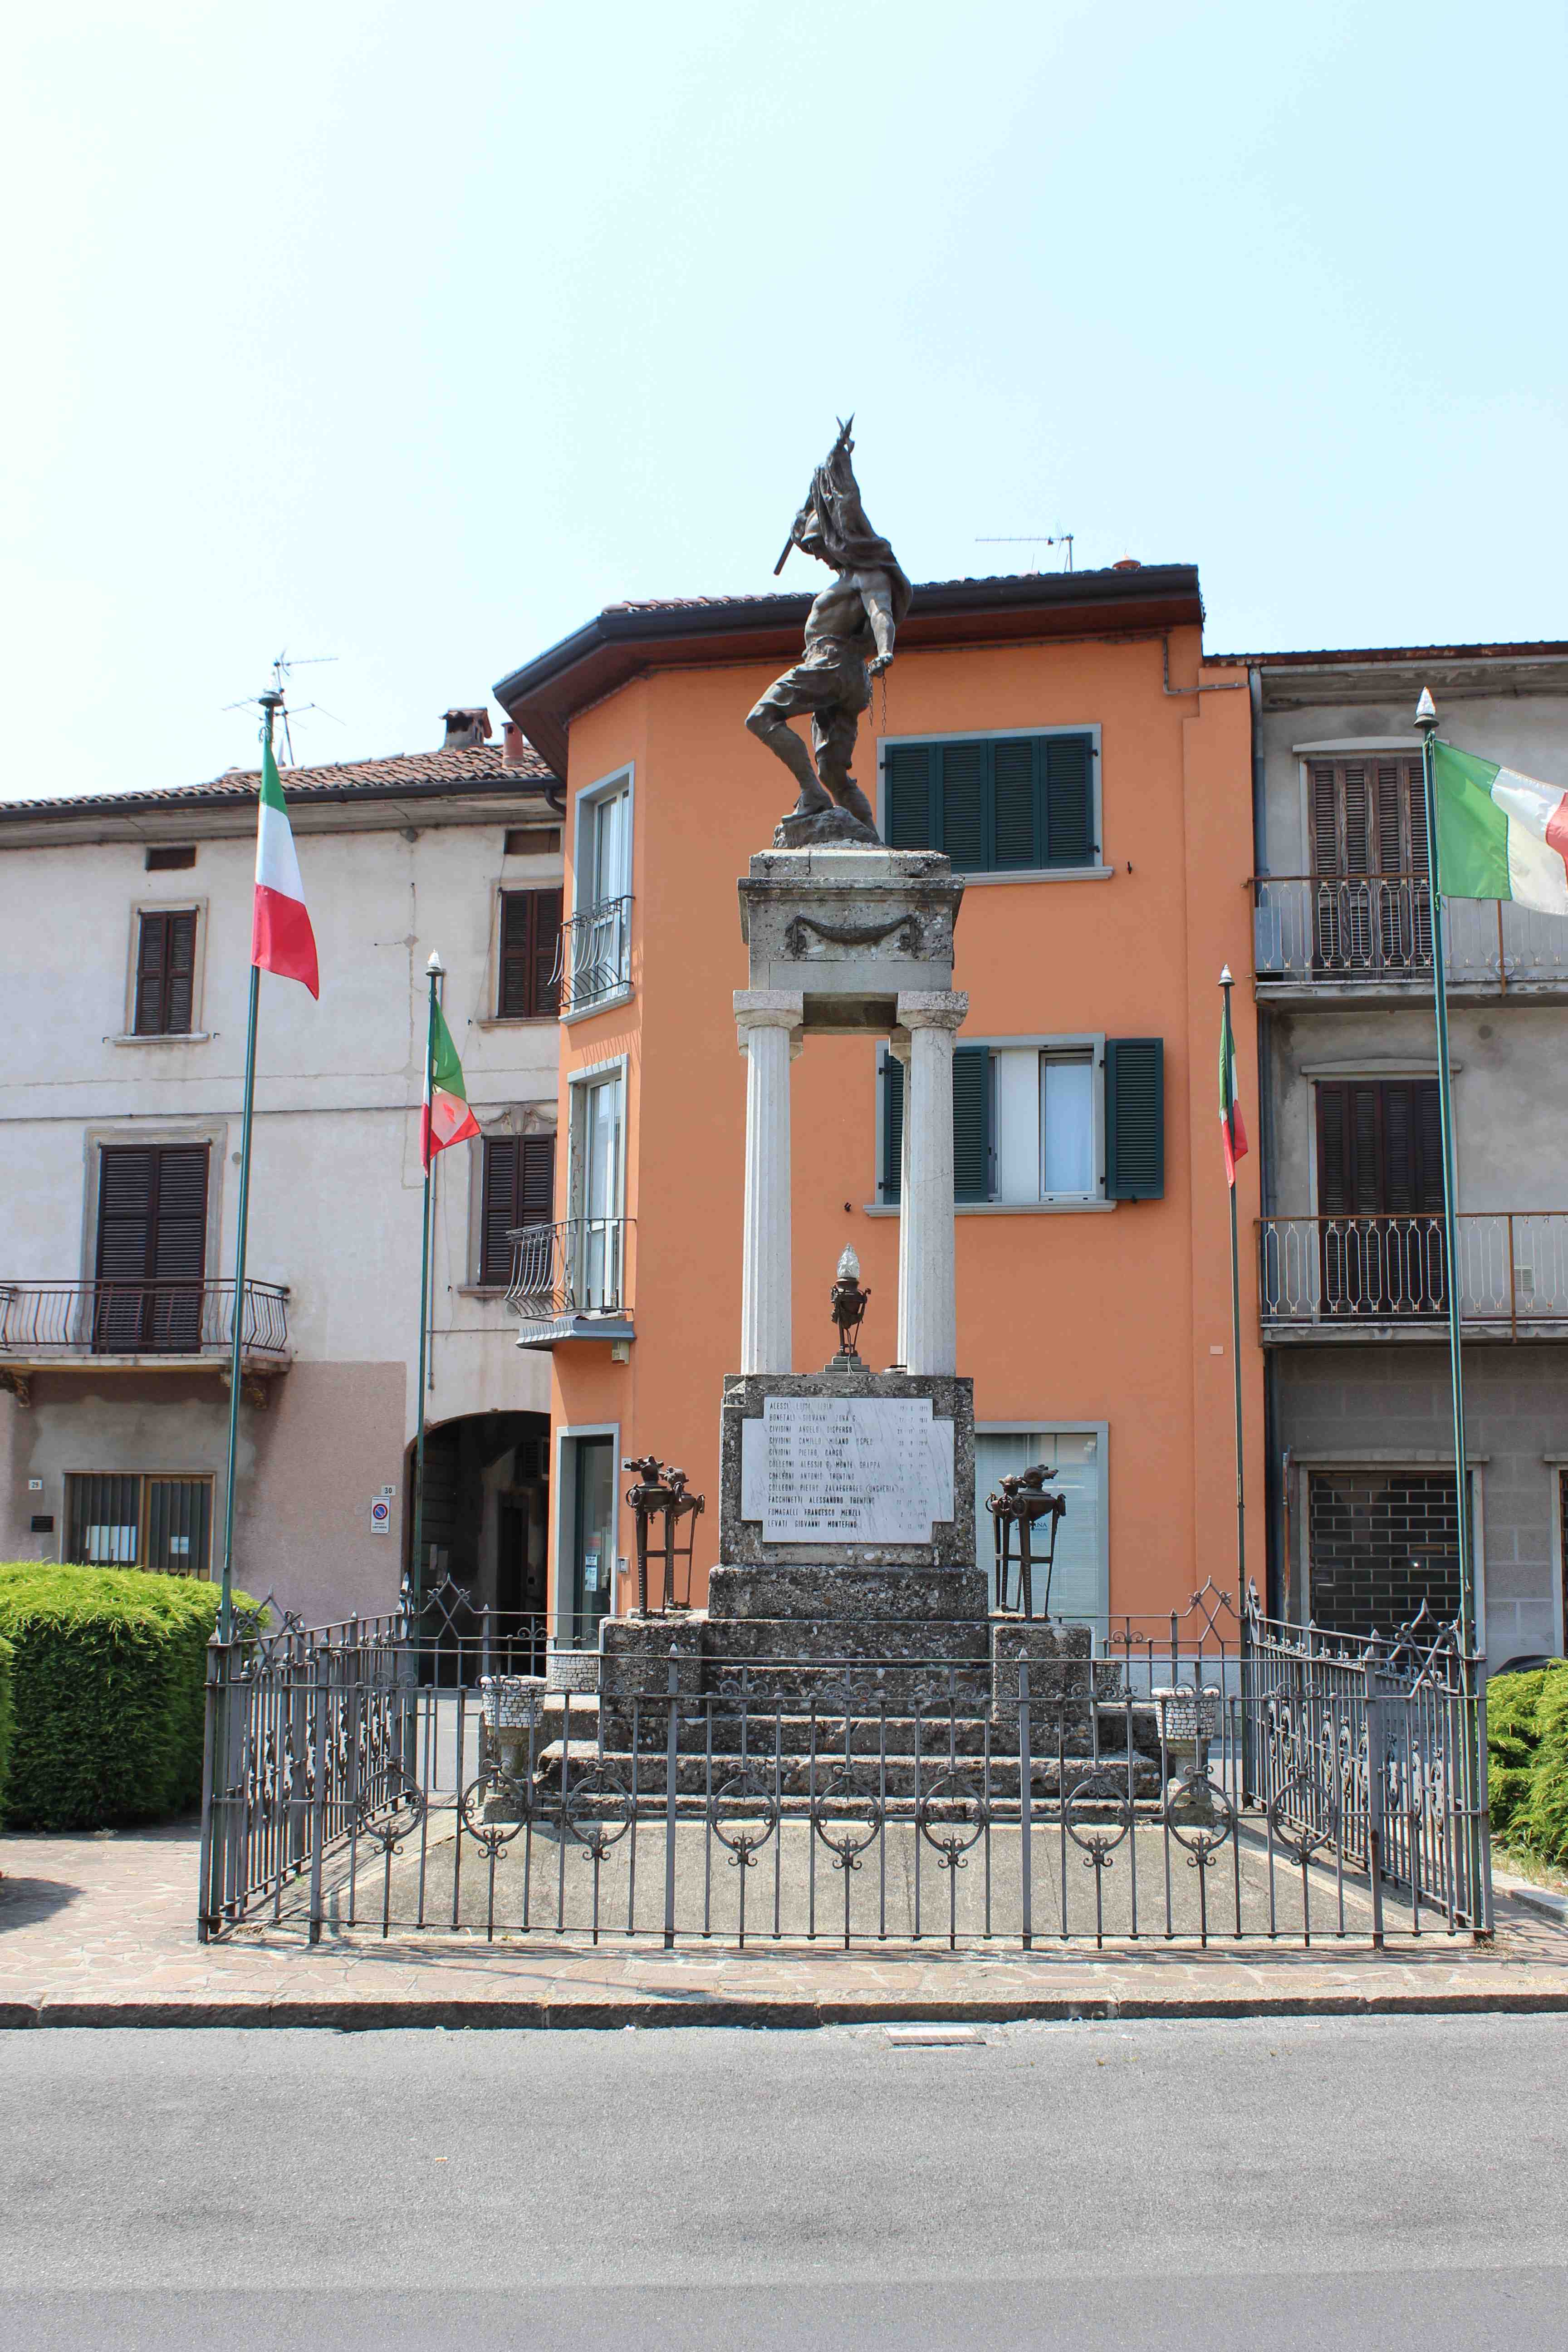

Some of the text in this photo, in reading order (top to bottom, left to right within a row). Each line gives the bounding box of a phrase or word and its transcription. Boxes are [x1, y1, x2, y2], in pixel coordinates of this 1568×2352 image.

[836, 1460, 853, 1469] MONTE
[769, 1472, 855, 1480] COLLEONI ANTONIO TRENTINO
[865, 1484, 899, 1494] (UNGHERIA)
[768, 1519, 787, 1528] LEVATI
[794, 1520, 820, 1528] GIOVANNI
[827, 1520, 857, 1529] MONTEFINO
